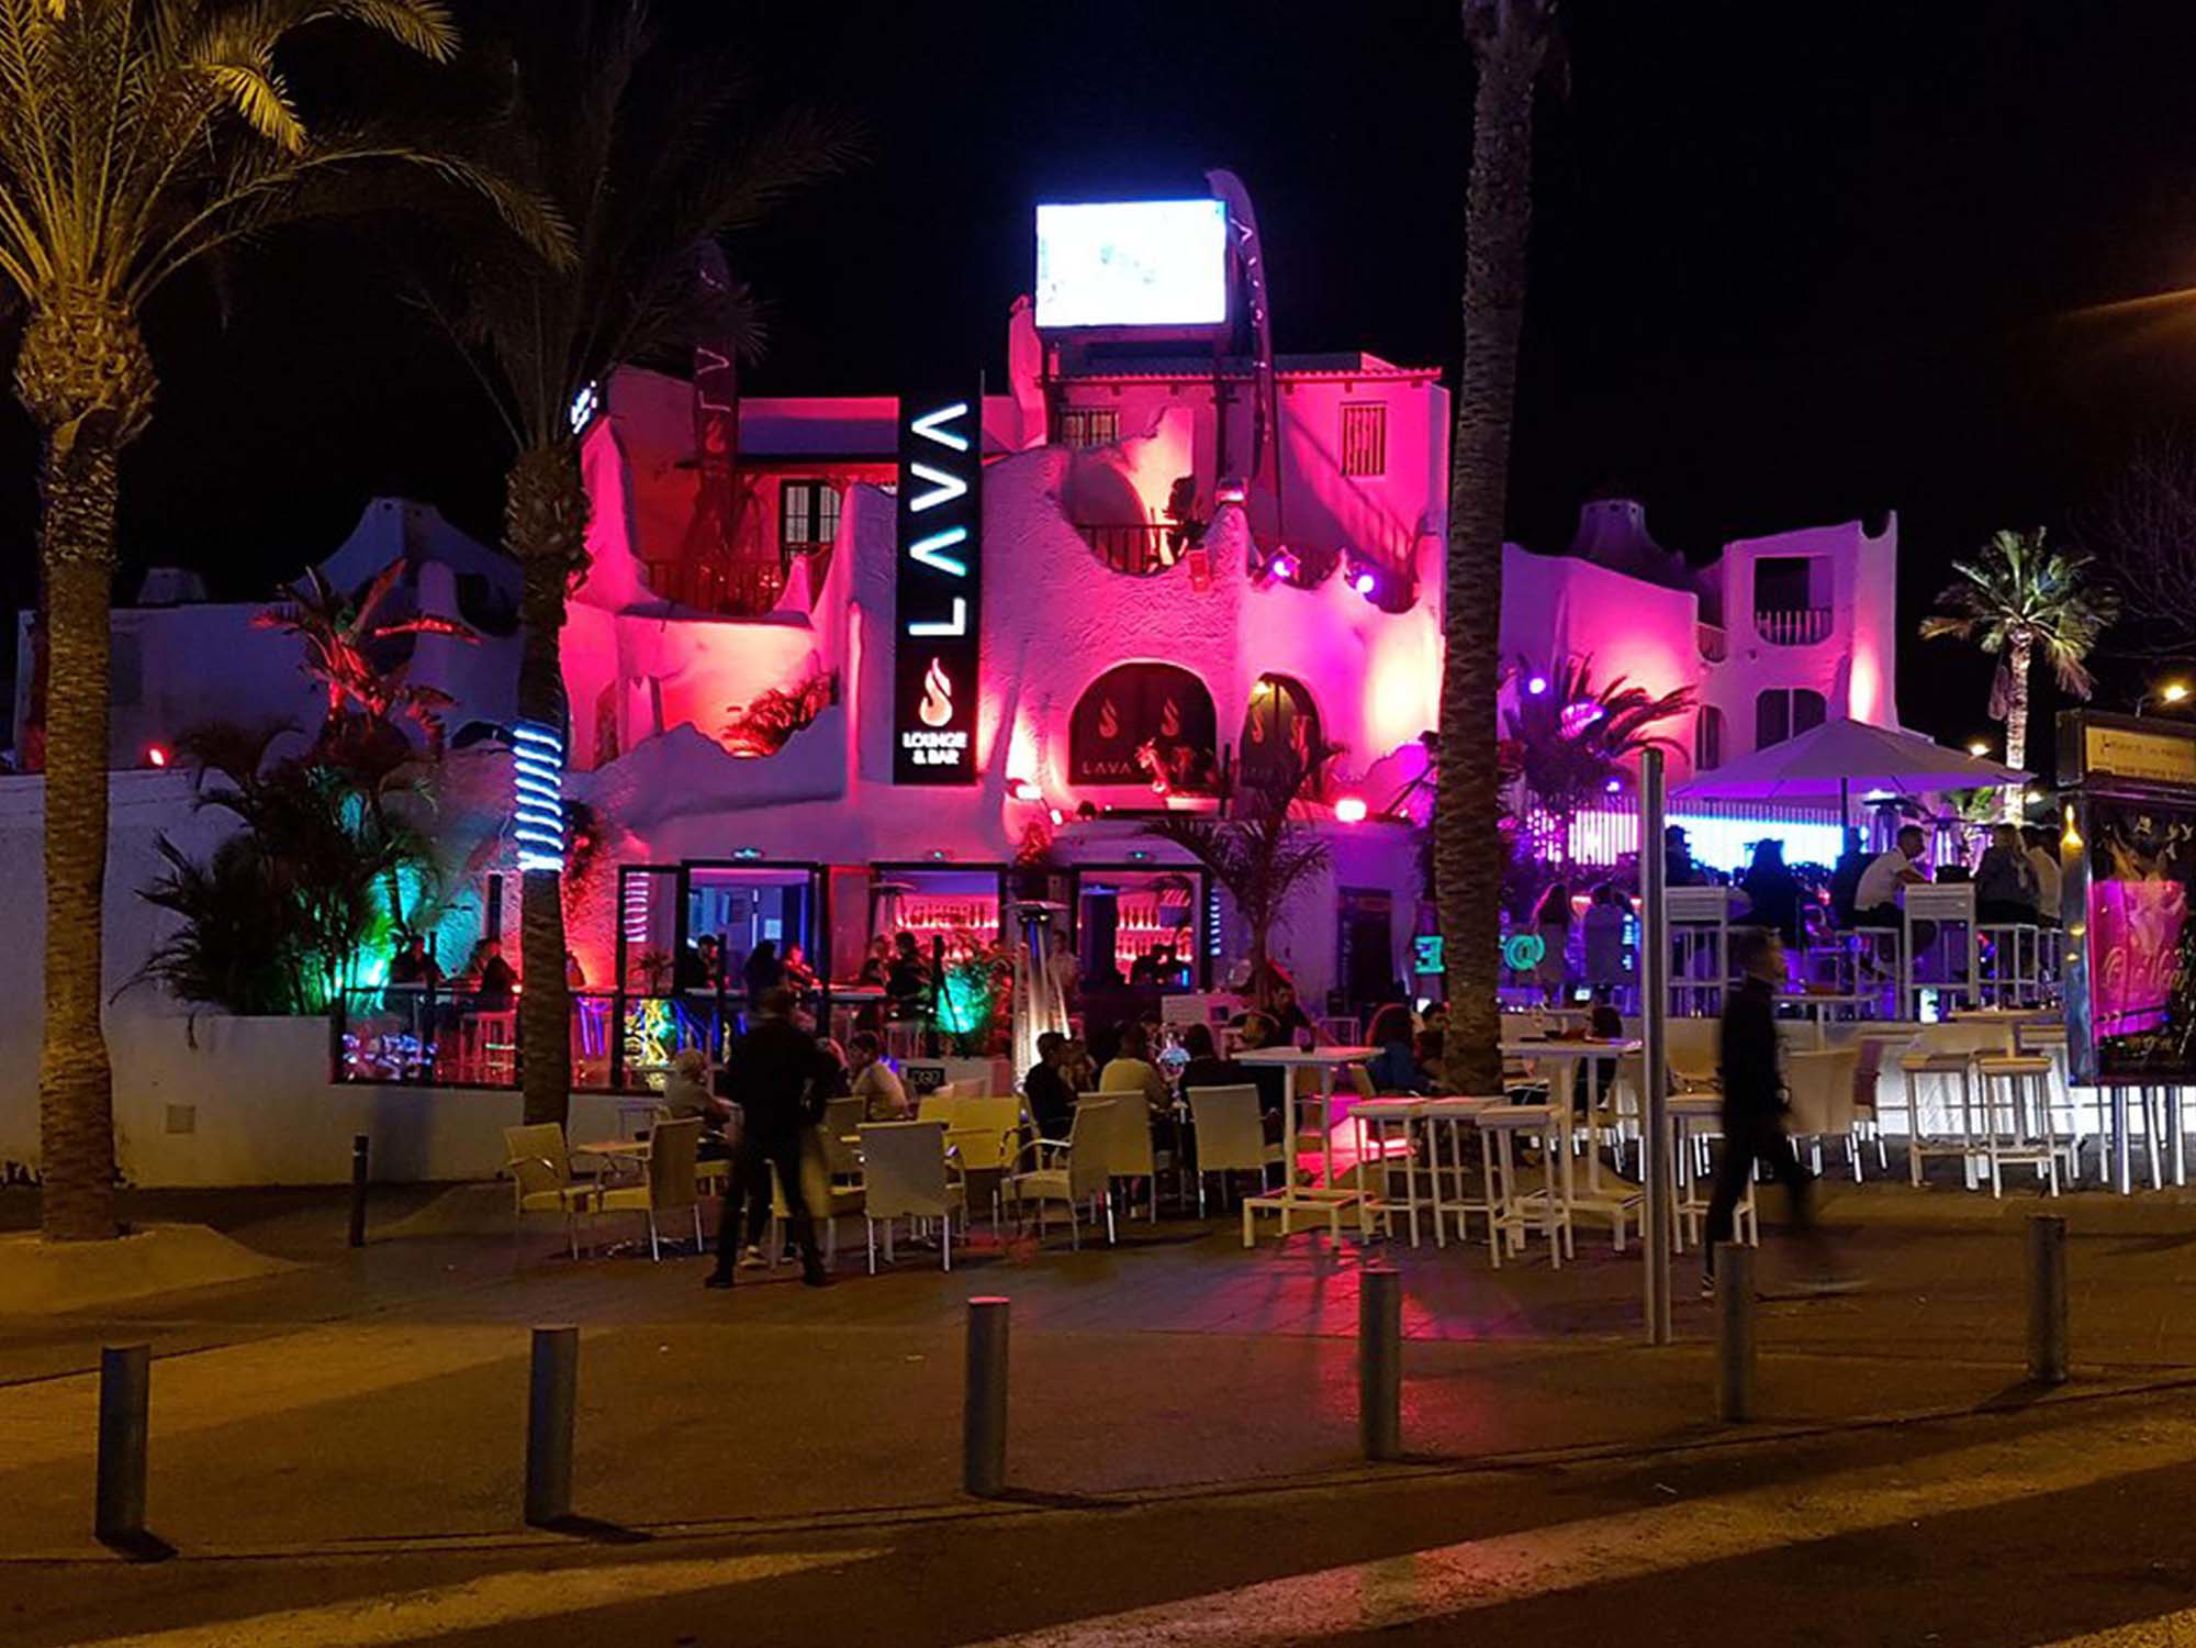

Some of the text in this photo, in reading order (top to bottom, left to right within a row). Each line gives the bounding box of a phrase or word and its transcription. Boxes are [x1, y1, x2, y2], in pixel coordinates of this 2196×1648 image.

[908, 403, 969, 636] LAVA
[902, 732, 968, 748] LOUNGE
[912, 748, 960, 765] & BAR
[1081, 760, 1133, 775] LAVA
